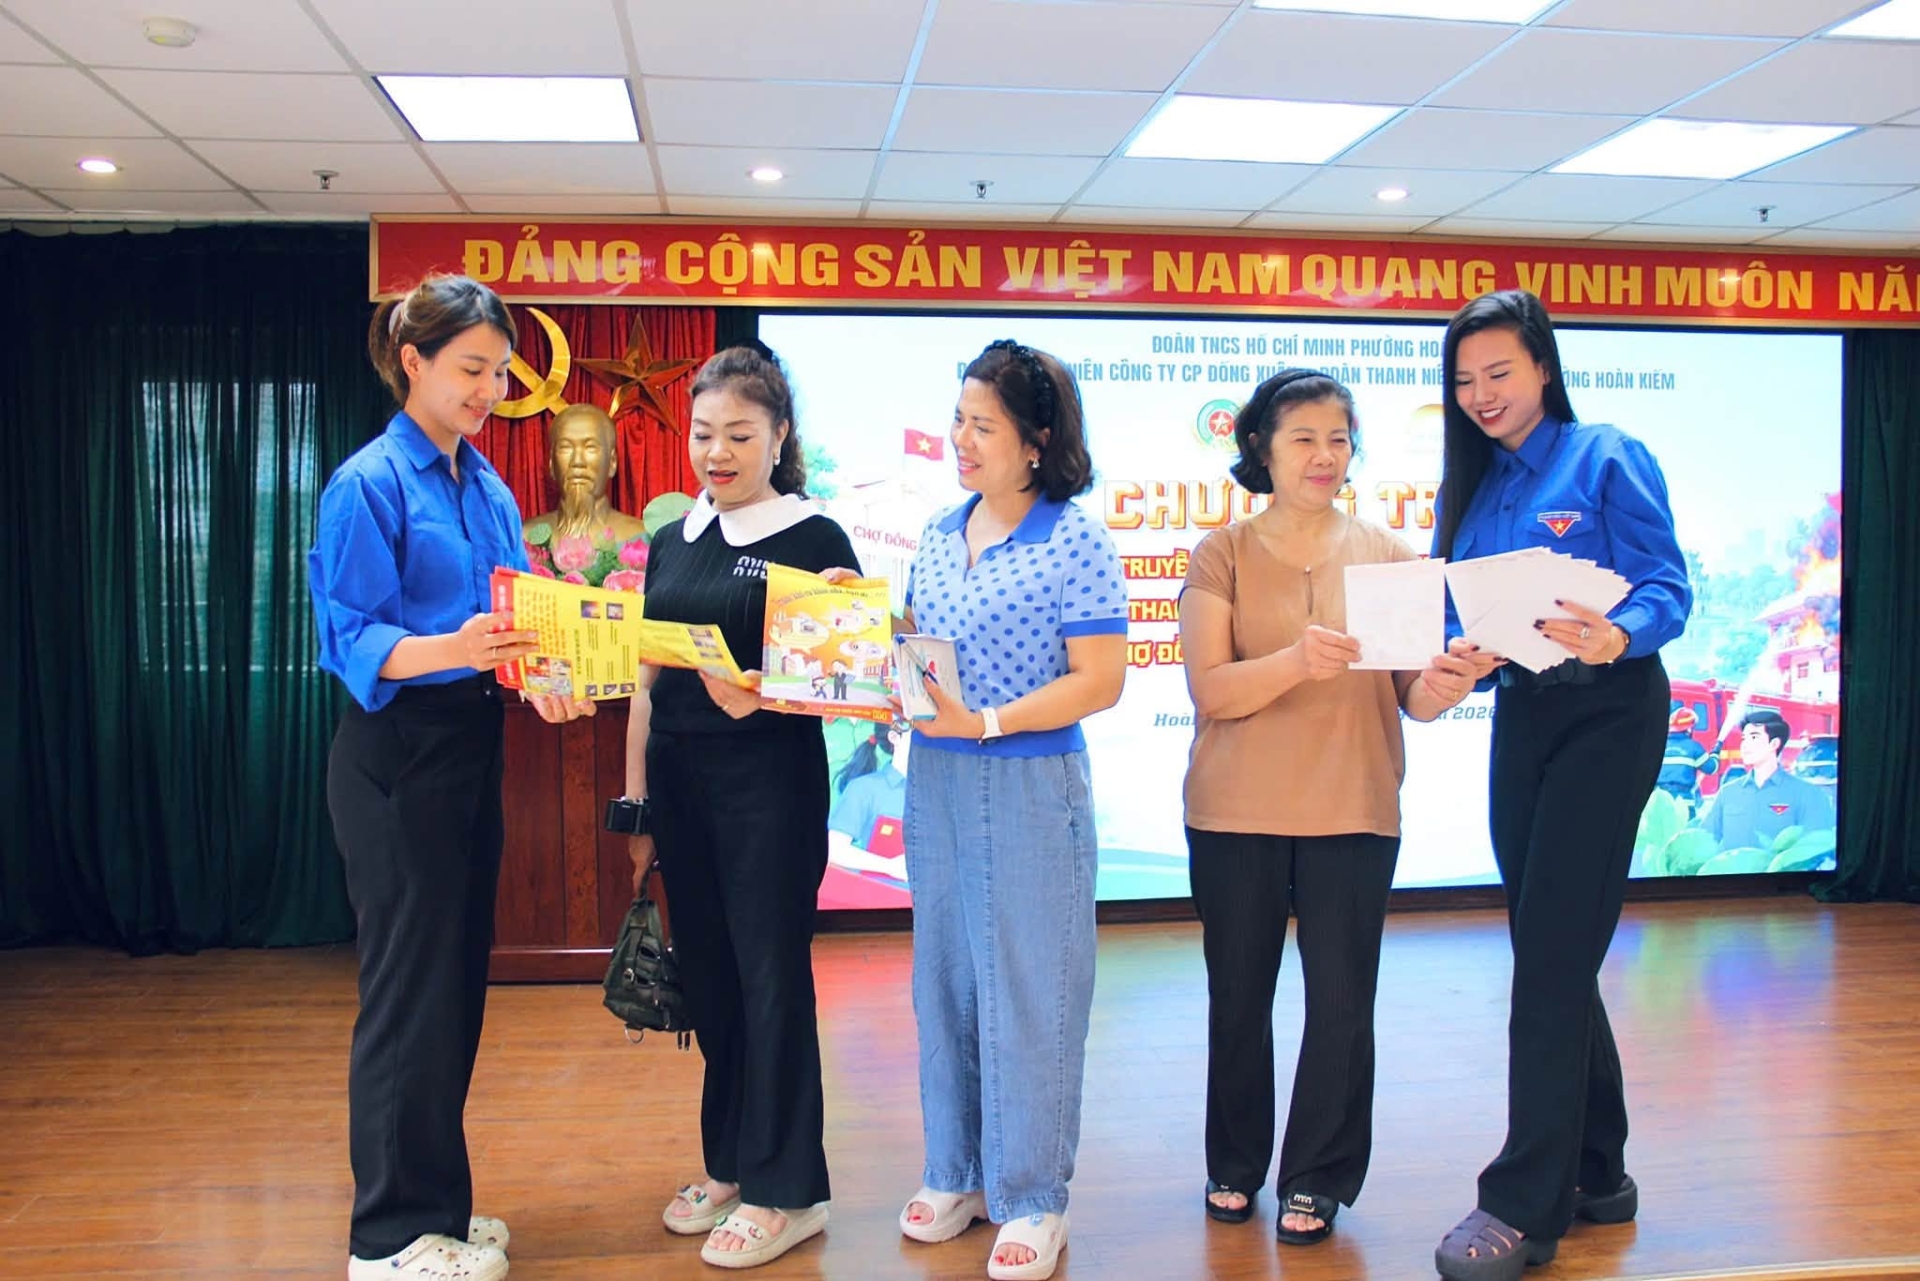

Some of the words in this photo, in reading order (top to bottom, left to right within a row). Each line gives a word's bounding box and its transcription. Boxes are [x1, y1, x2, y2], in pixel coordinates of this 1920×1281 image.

[462, 225, 640, 284] ĐẢNG
[665, 233, 839, 295] CỘNG
[854, 230, 982, 287] SẢN
[1003, 240, 1132, 298] VIỆT
[1153, 251, 1290, 295] NAM
[1302, 253, 1495, 300] QUANG
[1515, 262, 1642, 305] VINH
[1655, 261, 1812, 310] MUÔN
[1839, 265, 1920, 311] NĂ
[1200, 336, 1240, 354] TNCS
[1273, 334, 1298, 356] CHÍ
[1304, 338, 1345, 356] MINH
[1351, 334, 1414, 357] PHƯỜNG
[1420, 340, 1444, 358] HO
[1110, 358, 1152, 382] CÔNG
[1157, 364, 1176, 382] TY
[1182, 364, 1202, 382] CP
[1366, 366, 1416, 385] THANH
[1596, 367, 1634, 389] HOÀN
